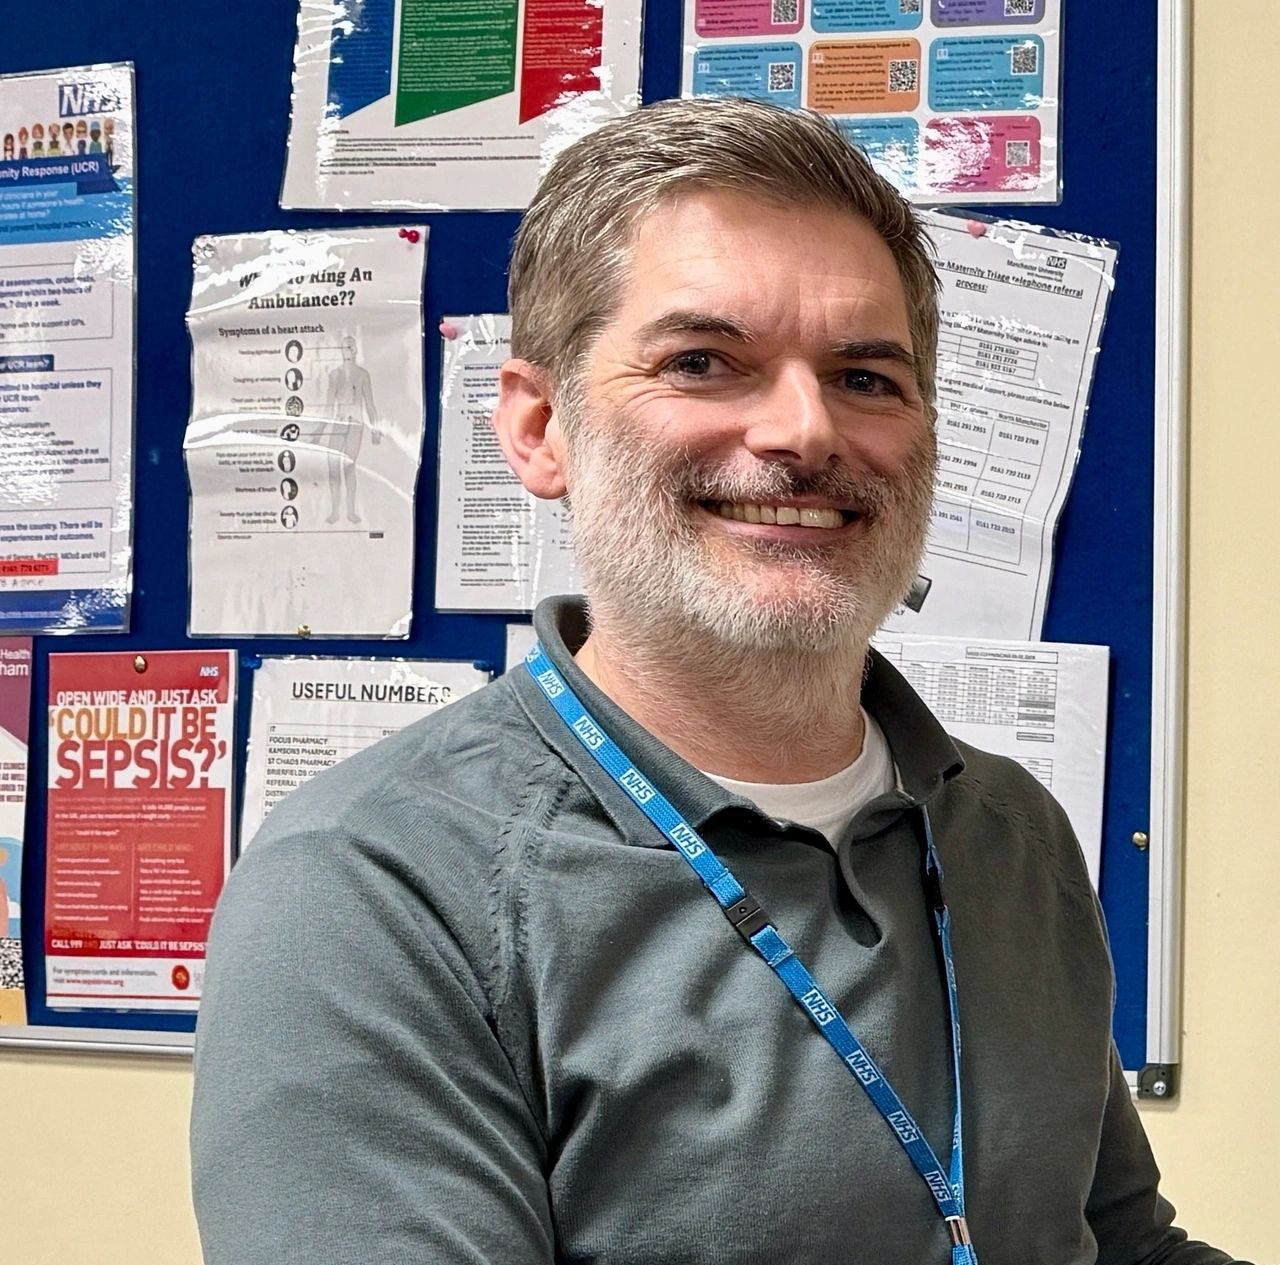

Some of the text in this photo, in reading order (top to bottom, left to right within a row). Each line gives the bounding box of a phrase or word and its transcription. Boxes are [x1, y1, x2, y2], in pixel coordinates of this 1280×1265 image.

[22, 161, 100, 178] Response (UCR)
[1007, 259, 1037, 271] Manchester
[1038, 267, 1064, 279] University
[1047, 256, 1067, 269] NHS
[349, 267, 373, 283] An
[947, 260, 985, 278] Maternity
[987, 269, 1013, 283] Triage
[1012, 275, 1052, 292] telephone
[1053, 285, 1084, 298] referral
[956, 279, 988, 293] process:
[248, 291, 356, 310] Ambulance??
[218, 327, 260, 338] Symptoms
[261, 326, 270, 334] of
[277, 325, 299, 334] heart
[300, 324, 325, 333] attack
[1, 649, 30, 660] Health
[200, 666, 219, 676] NHS
[292, 682, 451, 704] USEFUL NUMBERS
[540, 671, 563, 697] NHS
[57, 689, 218, 706] OPEN WIDE AND JUST ASK
[152, 707, 176, 739] IT
[181, 706, 217, 739] BE
[575, 717, 603, 748] NHS
[269, 736, 328, 745] FOCUS PHARMACY
[621, 771, 654, 803] NHS
[672, 826, 703, 857] NHS
[51, 939, 70, 949] CALL
[99, 941, 116, 949] JUST
[116, 941, 132, 949] ASK
[803, 991, 835, 1024] NHS
[848, 1051, 877, 1084] NHS
[888, 1112, 916, 1143] NHS
[927, 1172, 950, 1200] NHS
